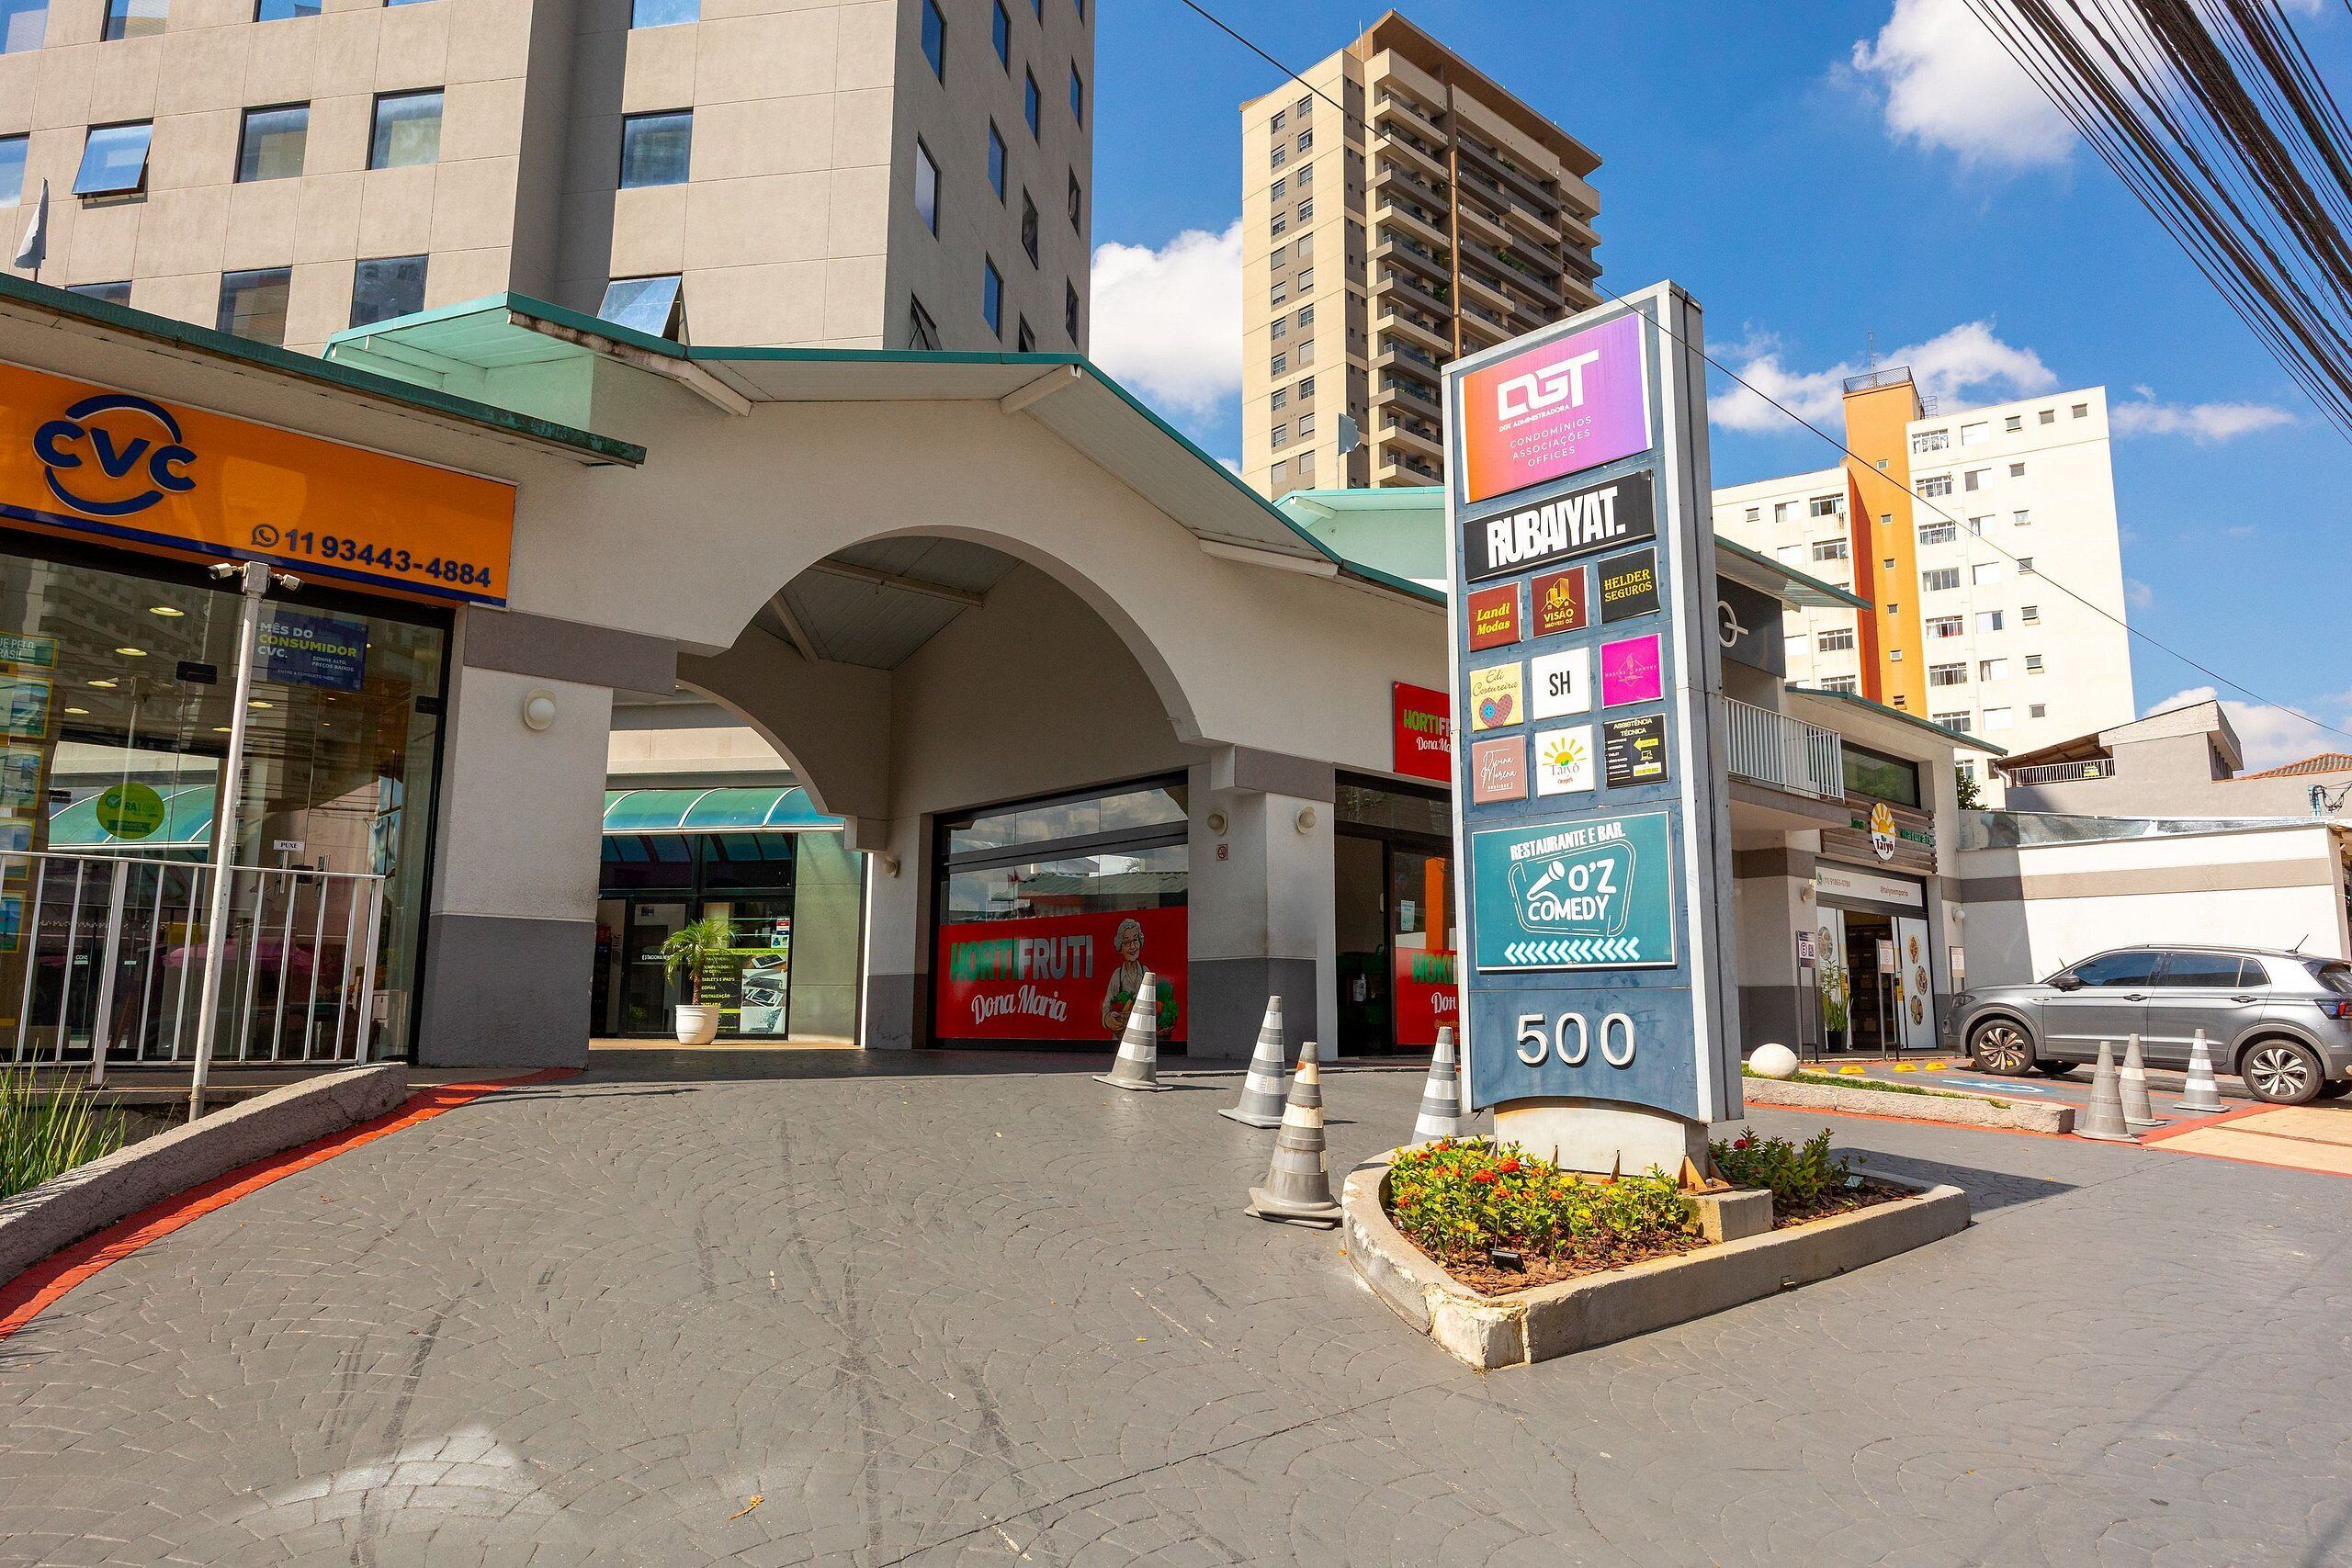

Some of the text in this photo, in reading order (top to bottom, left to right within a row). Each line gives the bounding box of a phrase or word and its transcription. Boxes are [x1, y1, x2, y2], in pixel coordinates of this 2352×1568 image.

[1498, 348, 1600, 422] DGT
[1499, 404, 1570, 433] DGT ADMINISTRADORA
[1510, 415, 1592, 448] CONDOMÍNIOS
[31, 419, 198, 493] CVC
[1512, 428, 1590, 460] ASSOCIAÇÕES
[1528, 446, 1576, 467] OFFICES
[1487, 486, 1626, 569] RUBAIYAT.
[322, 536, 492, 588] 93443-4884
[1603, 569, 1651, 591] HELDER
[1604, 581, 1653, 603] SEGUROS
[1476, 602, 1510, 622] Landi
[1544, 607, 1575, 623] VISÃO
[260, 622, 313, 638] MÊS DO
[1476, 620, 1510, 636] Modas
[257, 646, 288, 659] CVC.
[258, 634, 357, 658] CONSUMIDOR
[1486, 670, 1505, 683] Edi
[1549, 671, 1571, 696] SH
[1473, 682, 1519, 697] Costureira
[1613, 717, 1653, 729] ASSISTÊNCIA
[1621, 728, 1646, 737] TÉCNICA
[1416, 737, 1439, 750] Dona
[1510, 822, 1626, 861] RESTAURANTE E BAR.
[1528, 895, 1610, 921] COMEDY
[951, 935, 1092, 982] HORTIFRUTI
[971, 985, 1067, 1024] Dona Maria
[1517, 1012, 1635, 1067] 500
